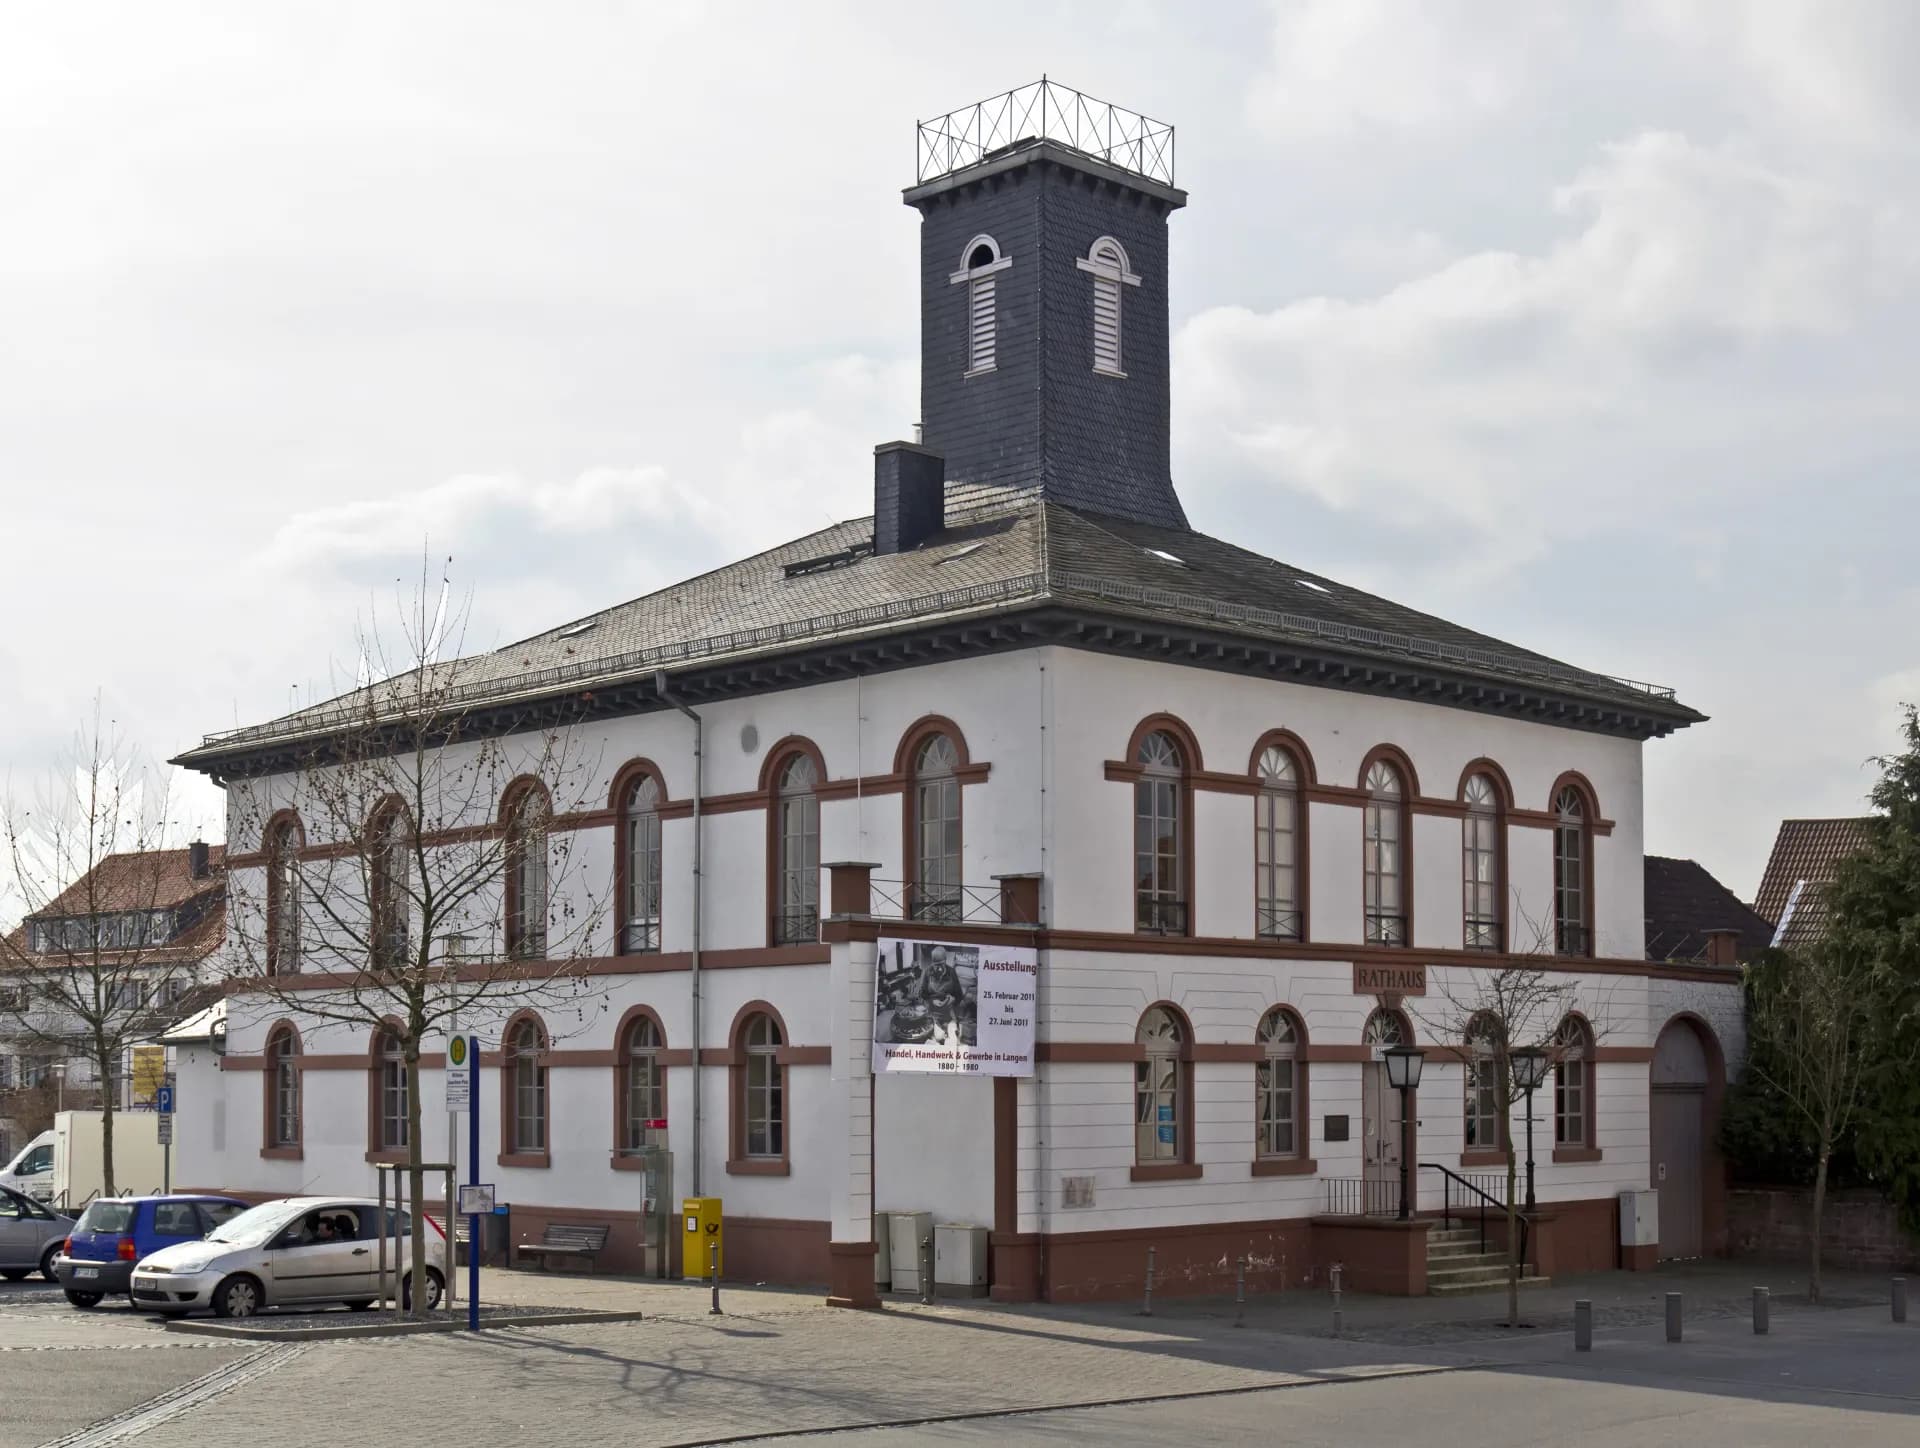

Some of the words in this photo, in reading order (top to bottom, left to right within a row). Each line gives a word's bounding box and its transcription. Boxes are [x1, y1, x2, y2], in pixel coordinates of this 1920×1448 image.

[983, 959, 1037, 976] Ausstellung
[1358, 968, 1424, 989] RATHAUS
[983, 990, 993, 1000] 25.
[995, 991, 1019, 1000] Februar
[1020, 992, 1035, 1001] 2011
[1004, 1005, 1014, 1013] bis
[989, 1017, 998, 1025] 27.
[1000, 1018, 1012, 1026] Juni
[1013, 1018, 1028, 1027] 2011
[885, 1049, 914, 1059] Handel,
[915, 1049, 954, 1060] Handwerk
[955, 1051, 961, 1060] &
[963, 1051, 993, 1061] Gewerbe
[994, 1051, 1001, 1061] in
[1002, 1052, 1028, 1064] Langen
[938, 1062, 955, 1071] 1880
[963, 1063, 979, 1071] 1980
[160, 1090, 169, 1111] P
